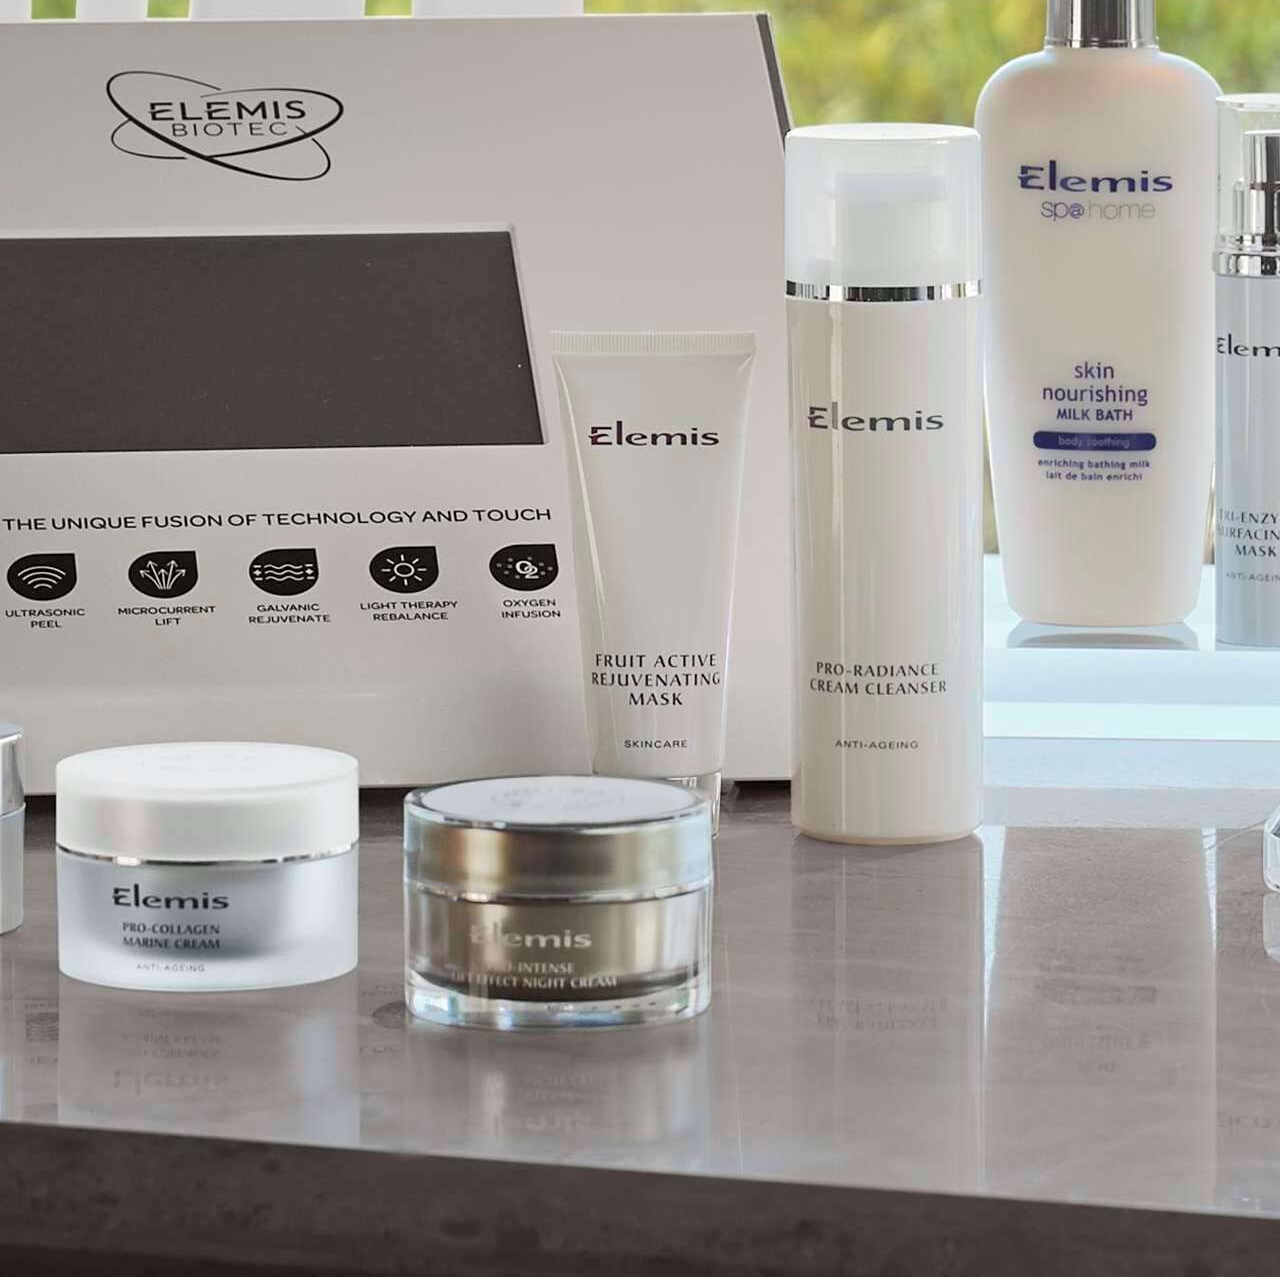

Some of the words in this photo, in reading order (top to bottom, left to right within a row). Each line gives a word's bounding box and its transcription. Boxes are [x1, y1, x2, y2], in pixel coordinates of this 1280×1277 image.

[149, 100, 306, 121] ELEMIS
[172, 122, 287, 137] BIOTEC
[1018, 160, 1173, 193] Elemis
[1074, 362, 1114, 379] skin
[1042, 386, 1148, 406] nourishing
[807, 402, 944, 431] Elemis
[1056, 409, 1090, 420] MILK
[1096, 409, 1133, 421] BATH
[588, 421, 720, 446] Elemis
[1038, 459, 1084, 470] enriching
[1129, 460, 1150, 468] milk
[2, 518, 47, 530] THE
[51, 516, 137, 530] UNIQUE
[142, 514, 222, 528] FUSION
[227, 514, 257, 527] OF
[262, 511, 417, 526] TECHNOLOGY
[421, 510, 468, 523] AND
[472, 509, 551, 522] TOUCH
[1234, 544, 1277, 557] MASK
[257, 603, 320, 612] GALVANIC
[360, 601, 399, 611] LIGHT
[403, 600, 458, 610] THERAPY
[503, 599, 556, 608] OXYGEN
[5, 608, 86, 617] ULTRASONIC
[118, 606, 215, 615] MICROCURRENT
[373, 612, 449, 621] REBALANCE
[501, 610, 561, 619] INFUSION
[30, 620, 62, 629] PEEL
[155, 618, 182, 626] LIFT
[248, 614, 331, 624] REJUVENATE
[596, 653, 647, 668] FRUIT
[653, 653, 717, 668] ACTIVE
[816, 661, 938, 677] PRO-RADIANCE
[592, 671, 721, 688] REJUVENATING
[810, 678, 859, 694] CREAM
[865, 679, 947, 696] CLEANSER
[628, 692, 683, 706] MASK
[624, 740, 688, 749] SKINCARE
[835, 740, 919, 750] ANTI-AGEING
[112, 883, 229, 910] Elemis
[122, 922, 220, 935] PRO-COLLAGEN
[123, 936, 169, 949] MARINE
[174, 938, 220, 950] CREAM
[136, 963, 206, 972] ANTI-AGEING
[522, 977, 565, 988] NIGHT
[570, 976, 618, 988] CREAM
